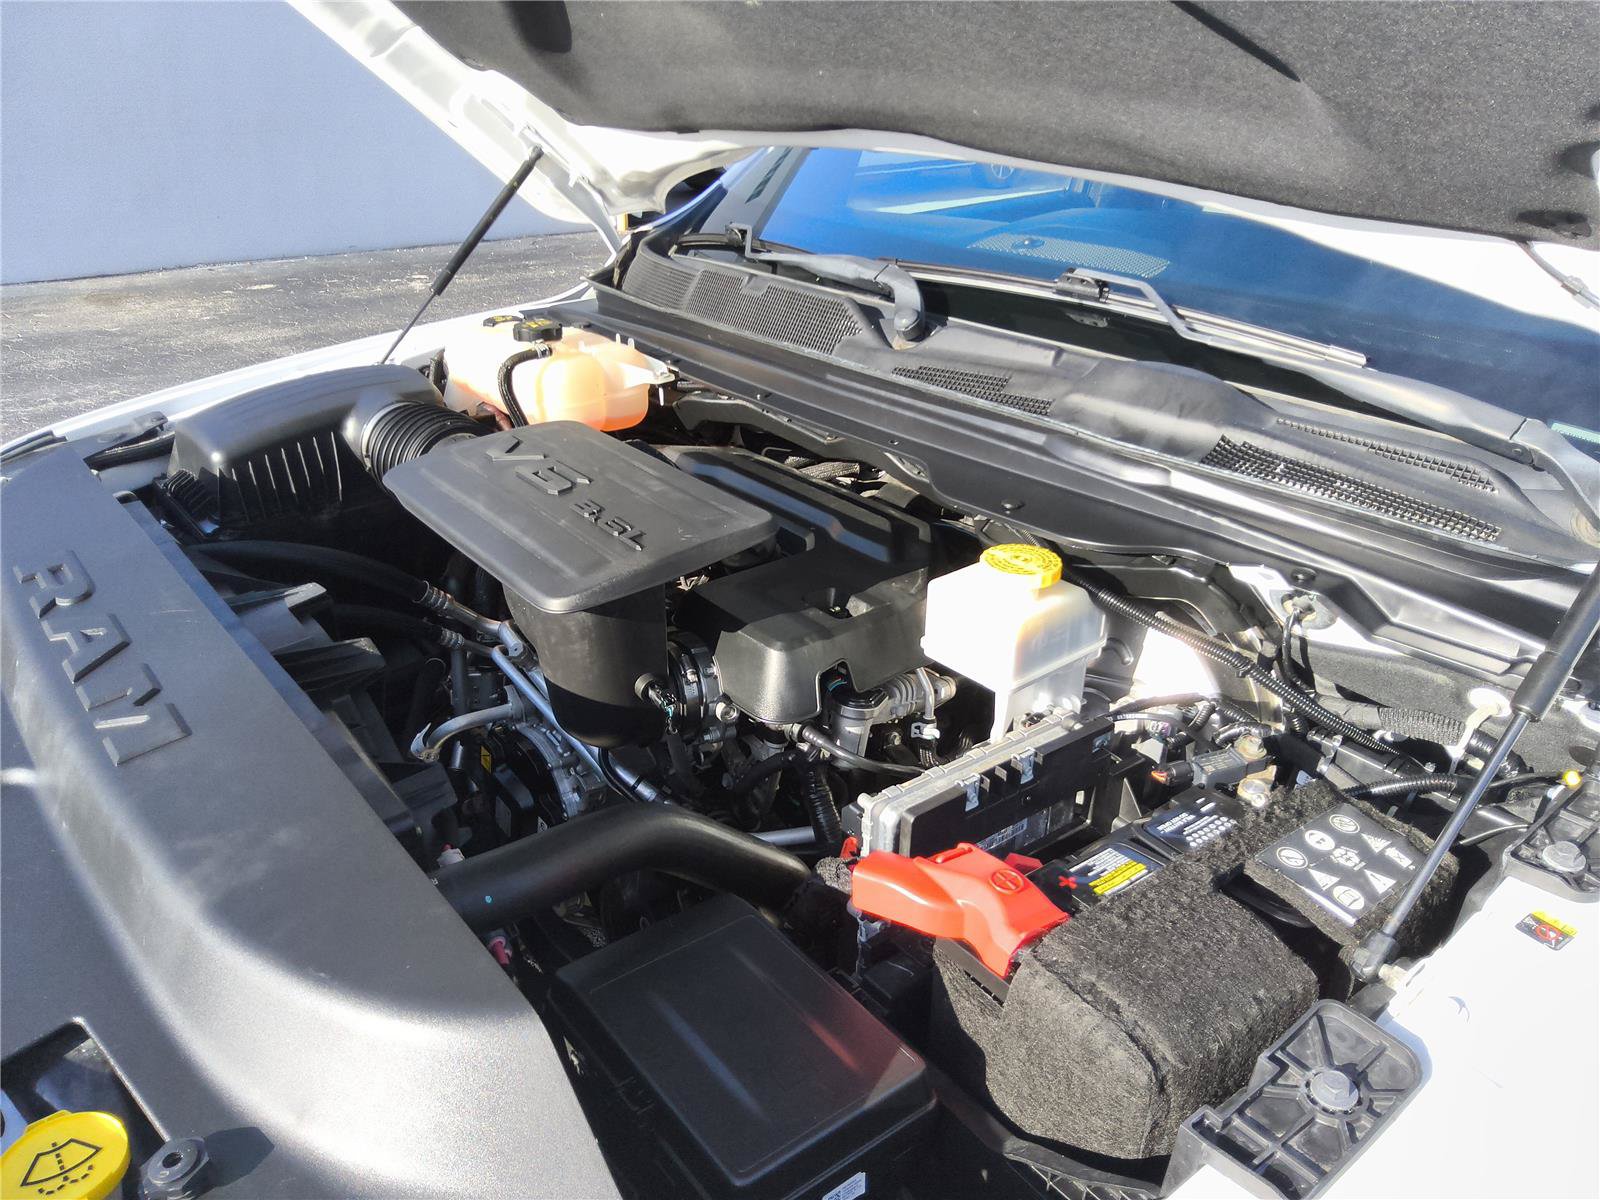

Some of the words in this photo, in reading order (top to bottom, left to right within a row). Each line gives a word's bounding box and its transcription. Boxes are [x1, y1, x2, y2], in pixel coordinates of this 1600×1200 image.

[486, 435, 593, 496] V6
[569, 499, 646, 551] 3.6L
[12, 549, 193, 767] RAM
